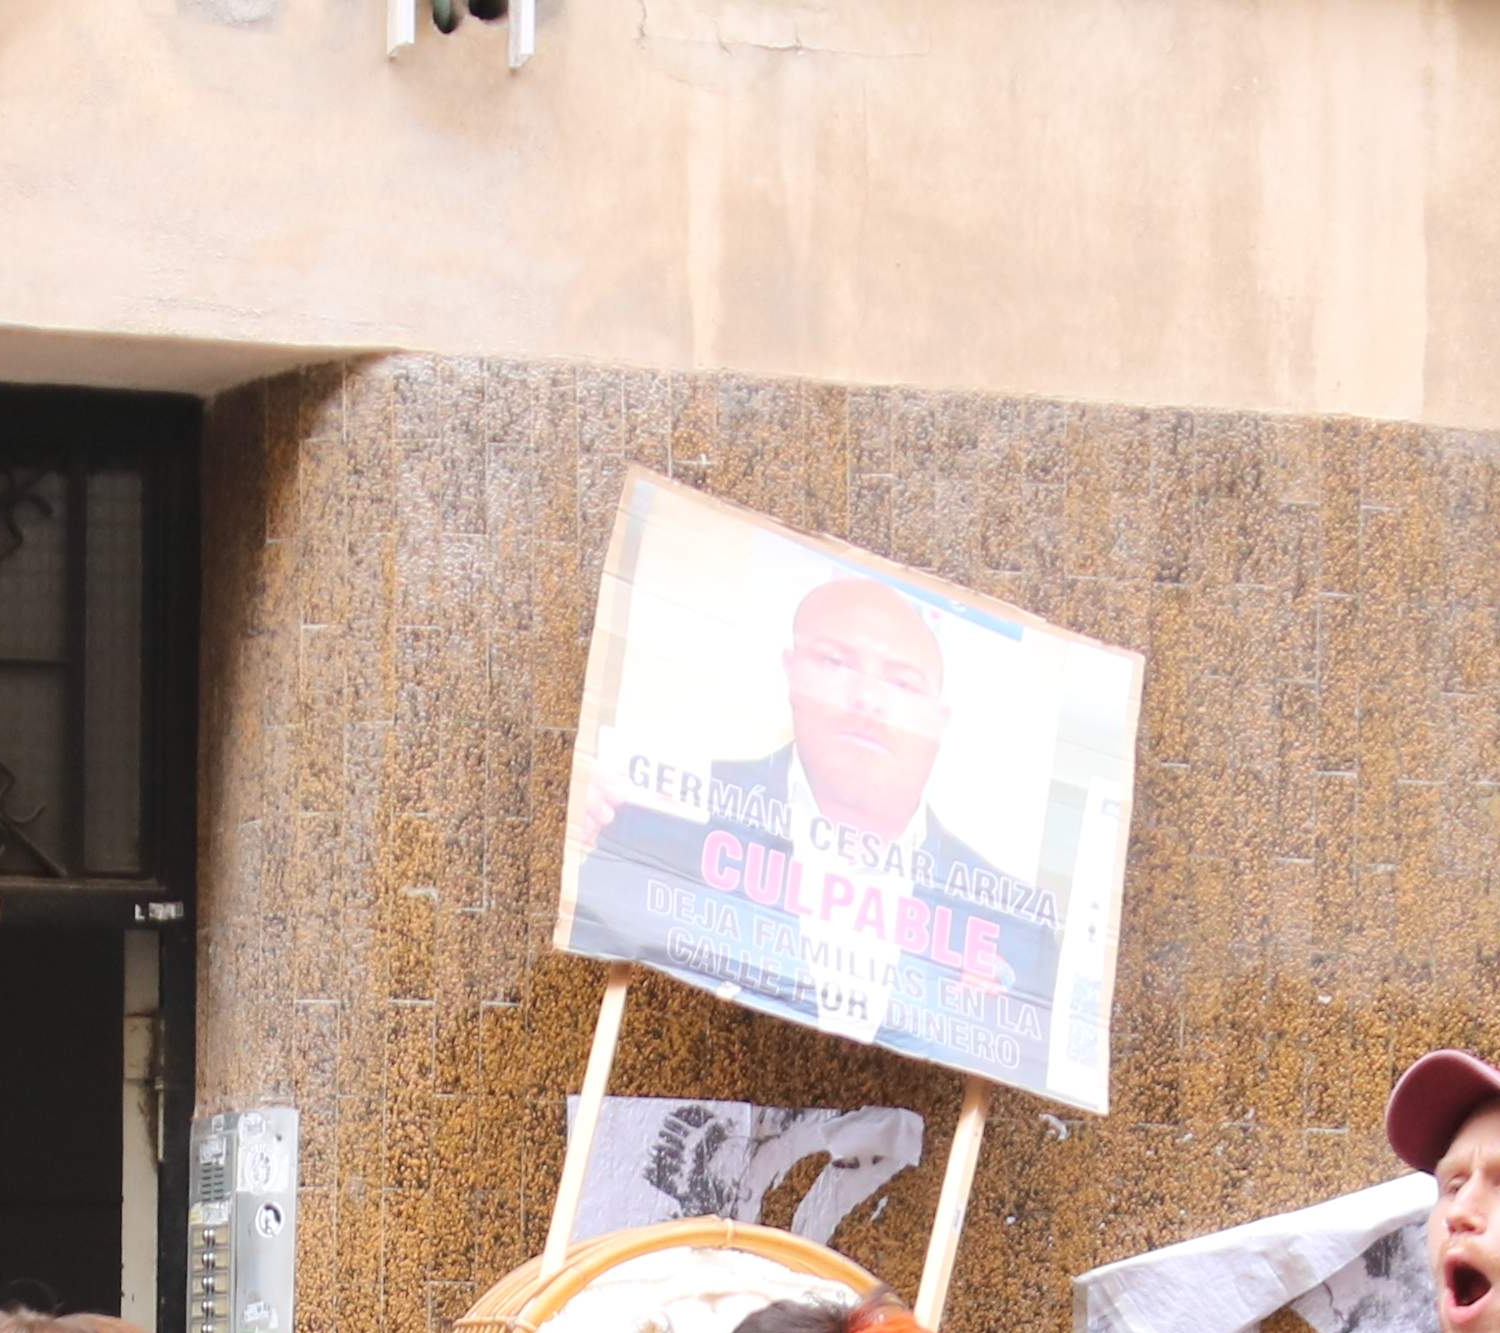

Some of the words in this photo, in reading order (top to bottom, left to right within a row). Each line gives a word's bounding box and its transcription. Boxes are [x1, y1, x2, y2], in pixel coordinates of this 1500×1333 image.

[629, 755, 794, 840] GERMÁN
[809, 815, 934, 886] CESAR
[945, 860, 1061, 932] ARIZA
[702, 829, 1001, 976] CULPABLE
[647, 880, 740, 939] DEJA
[751, 909, 925, 999] FAMILIAS
[938, 975, 987, 1019] EN
[996, 997, 1042, 1040] LA
[667, 926, 783, 996] CALLE
[793, 976, 869, 1021] POR
[887, 1003, 1021, 1069] DINERO
